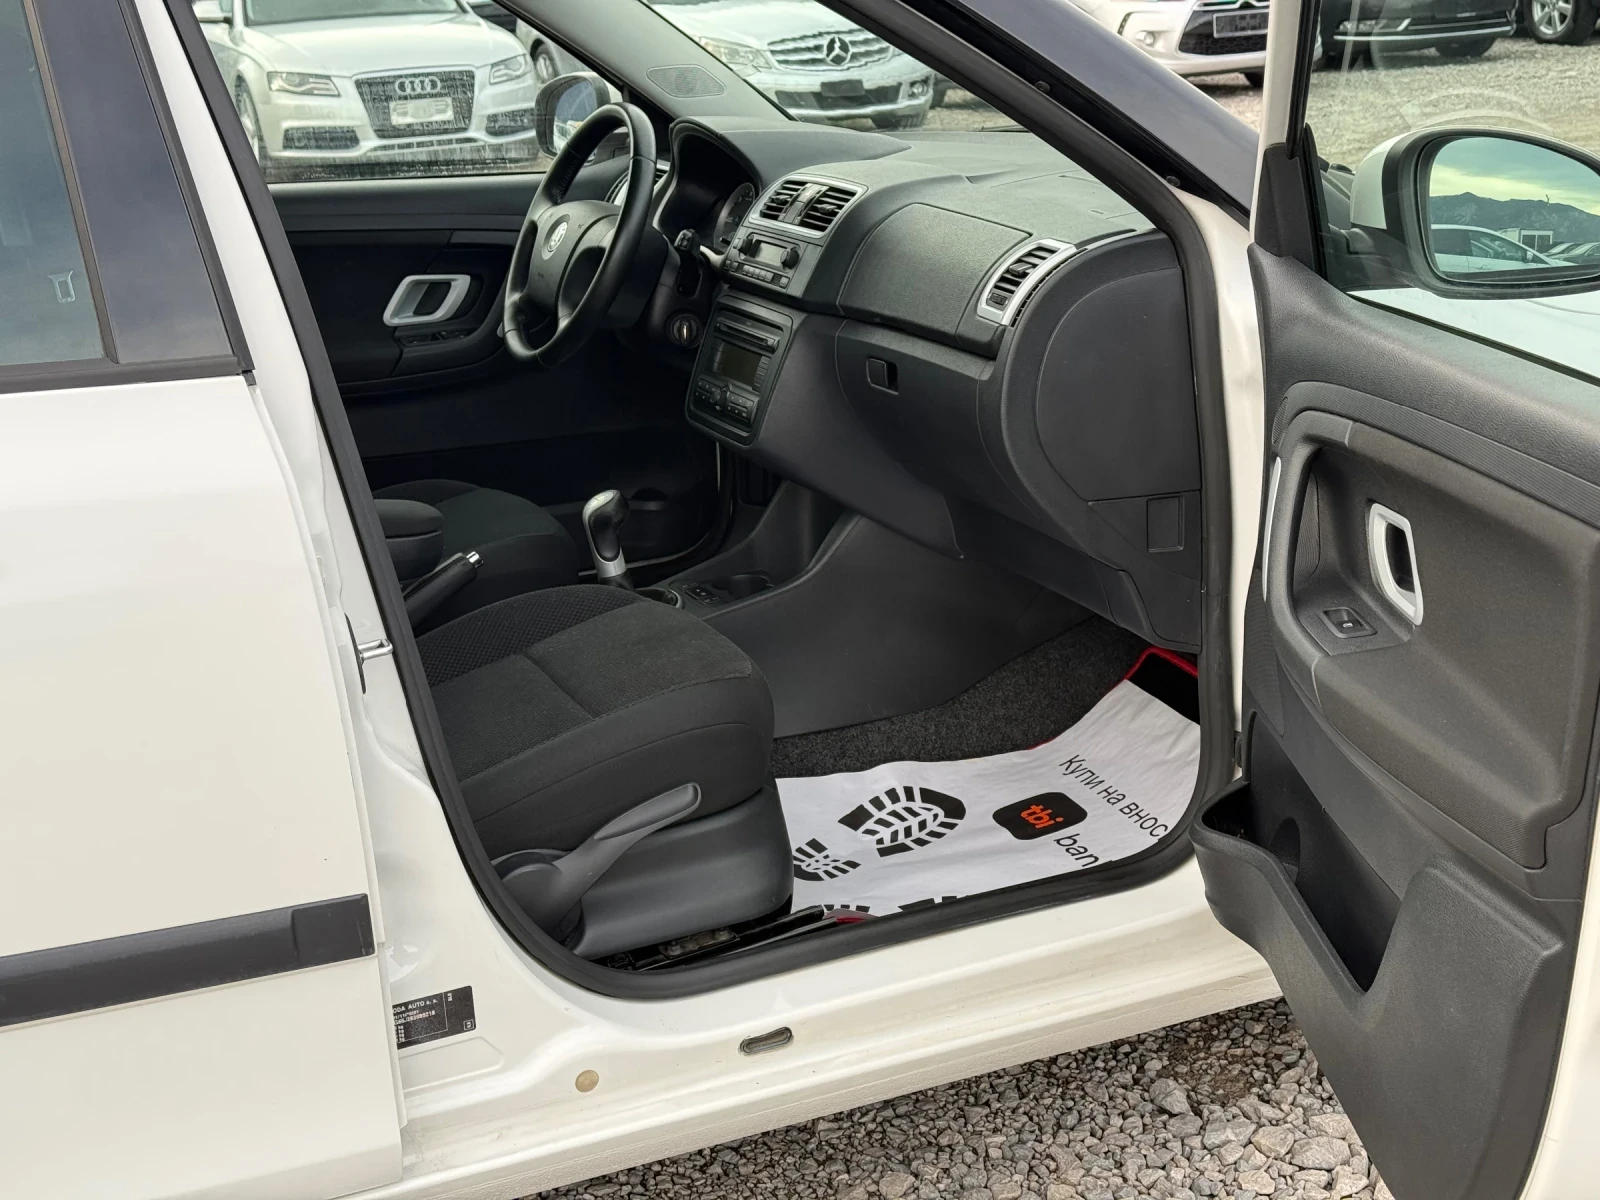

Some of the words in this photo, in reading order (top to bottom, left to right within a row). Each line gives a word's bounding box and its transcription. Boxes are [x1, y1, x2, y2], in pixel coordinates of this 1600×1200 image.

[1059, 754, 1105, 790] Купи
[1097, 785, 1127, 806] на
[1118, 802, 1169, 838] внос
[1020, 803, 1065, 829] tbi
[1053, 833, 1101, 868] ban
[393, 1005, 406, 1013] ODA
[408, 1001, 425, 1010] AUTO
